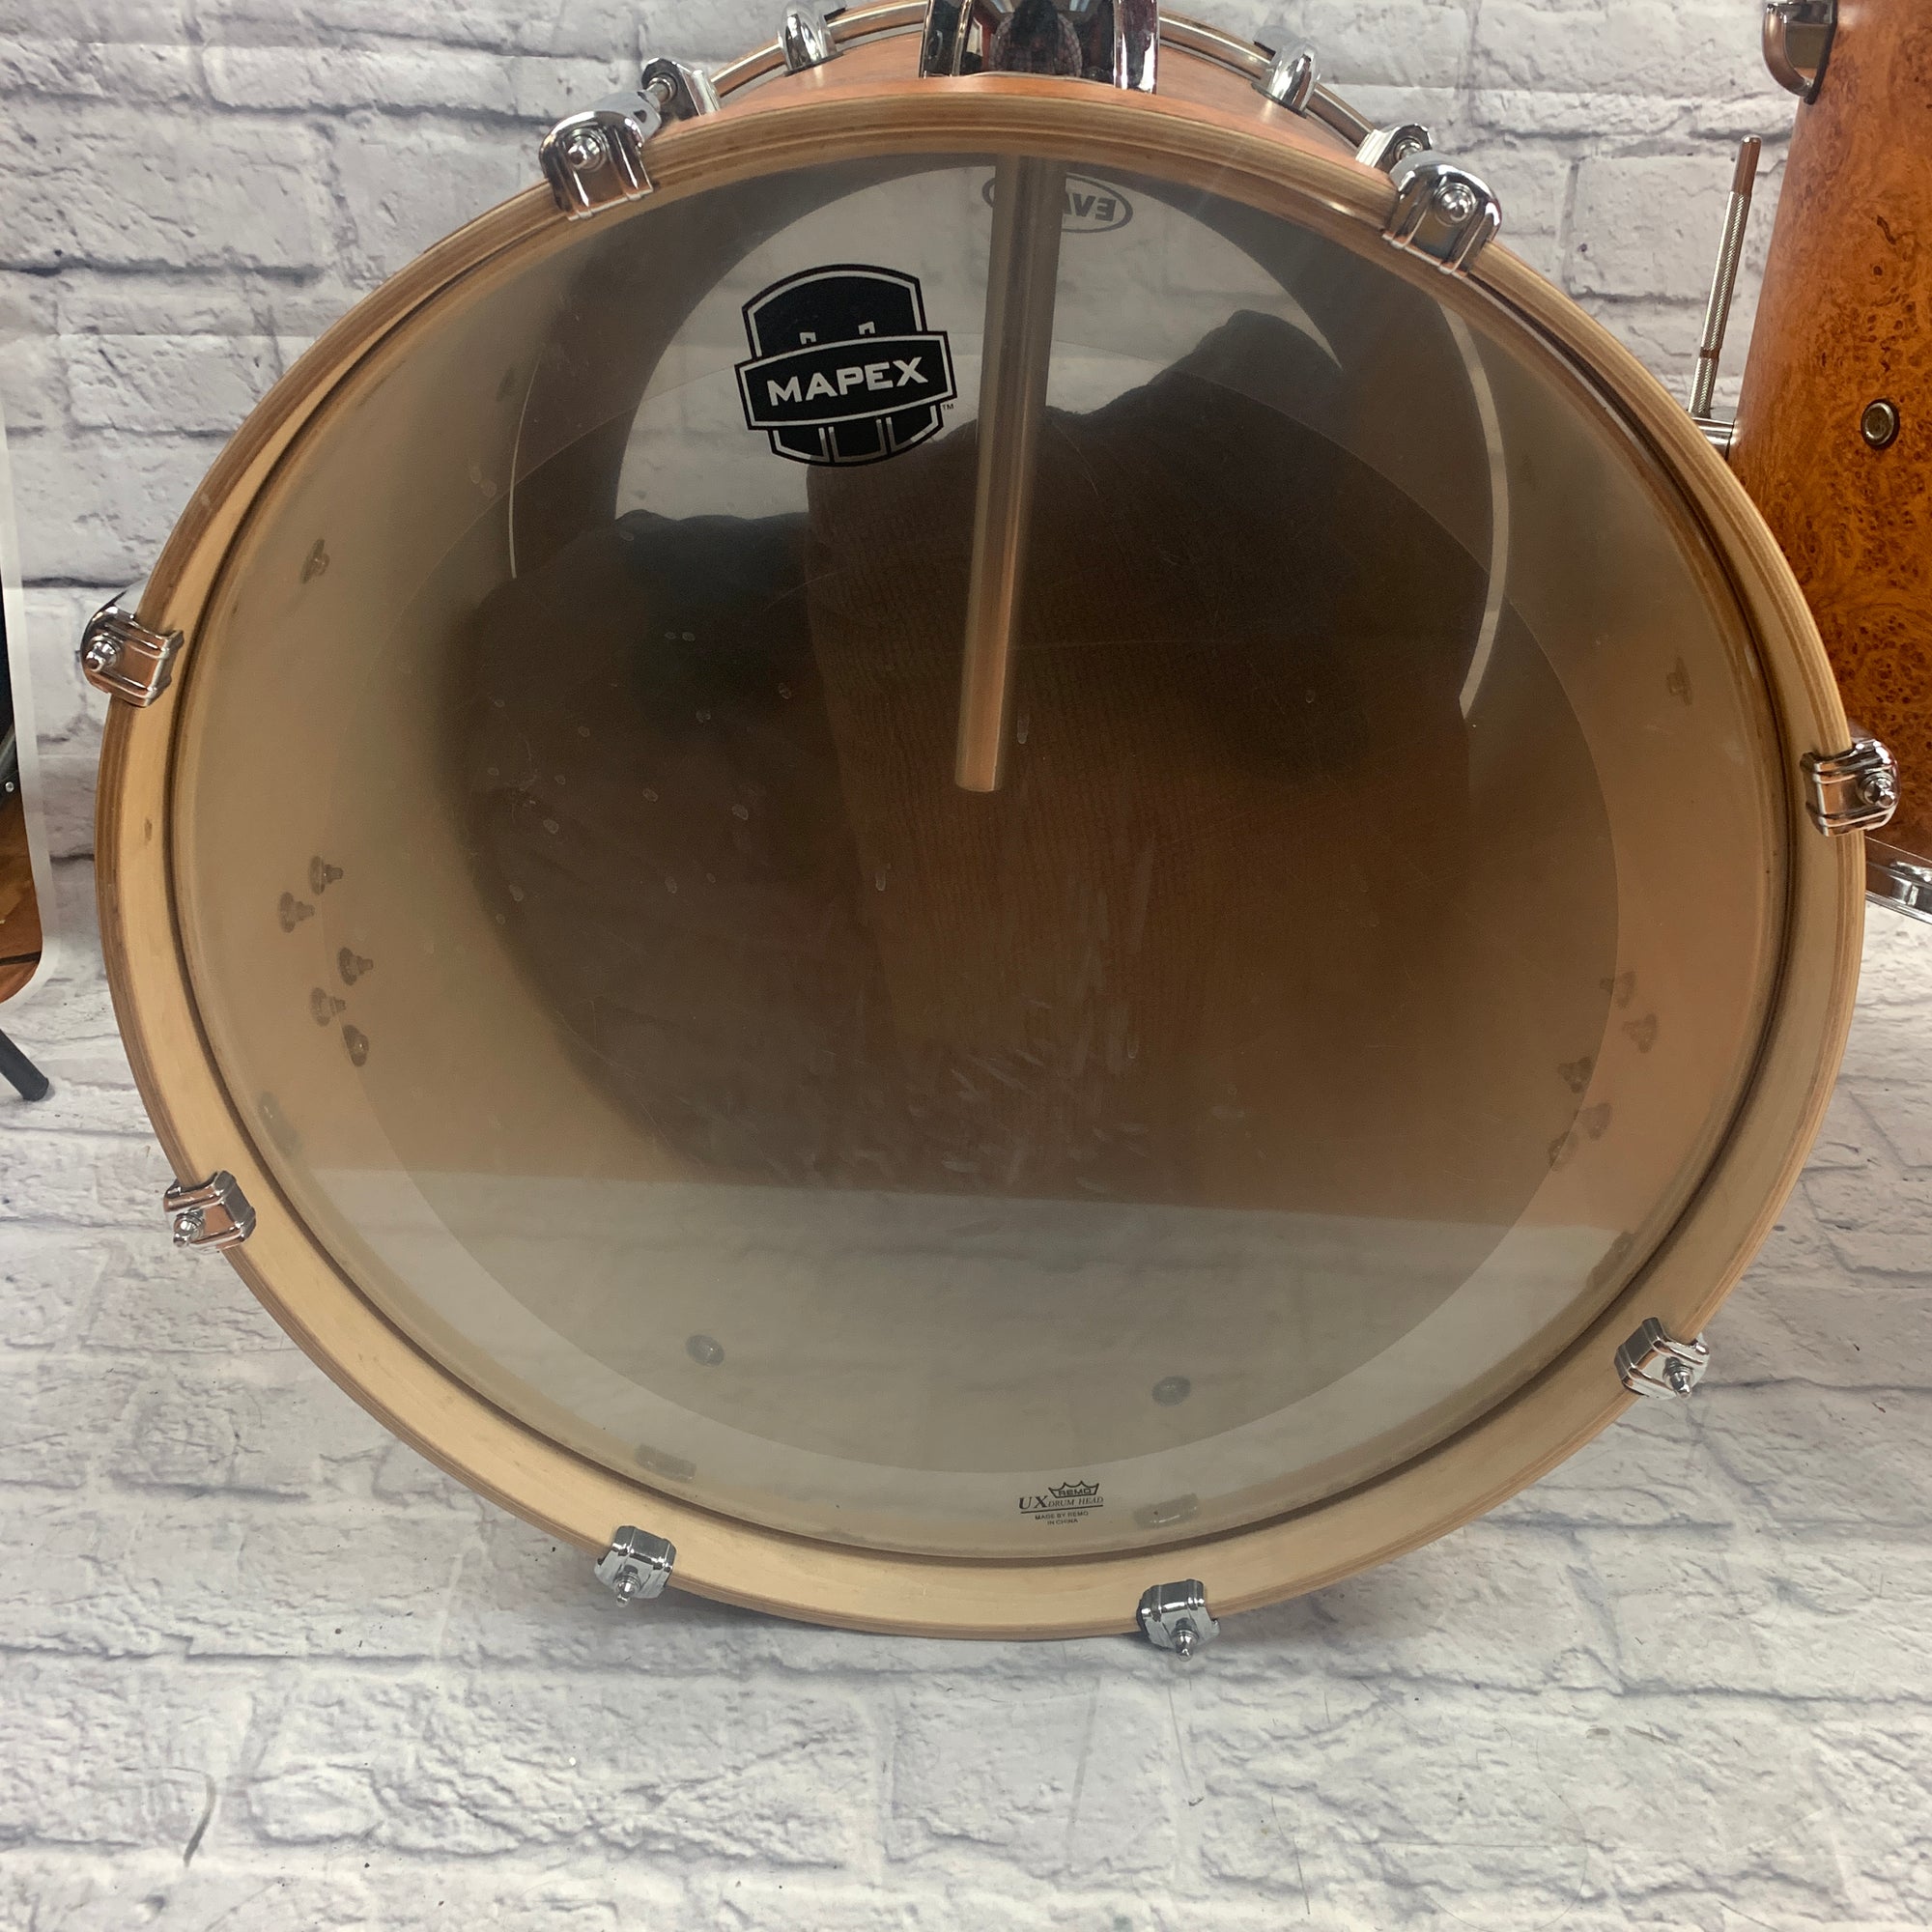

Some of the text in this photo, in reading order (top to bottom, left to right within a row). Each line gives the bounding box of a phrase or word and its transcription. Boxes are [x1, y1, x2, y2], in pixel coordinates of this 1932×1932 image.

[766, 356, 929, 407] MAPEX
[1058, 1488, 1092, 1496] REMO
[1018, 1494, 1104, 1510] UX DRUM HEAD
[1035, 1512, 1056, 1520] MADE
